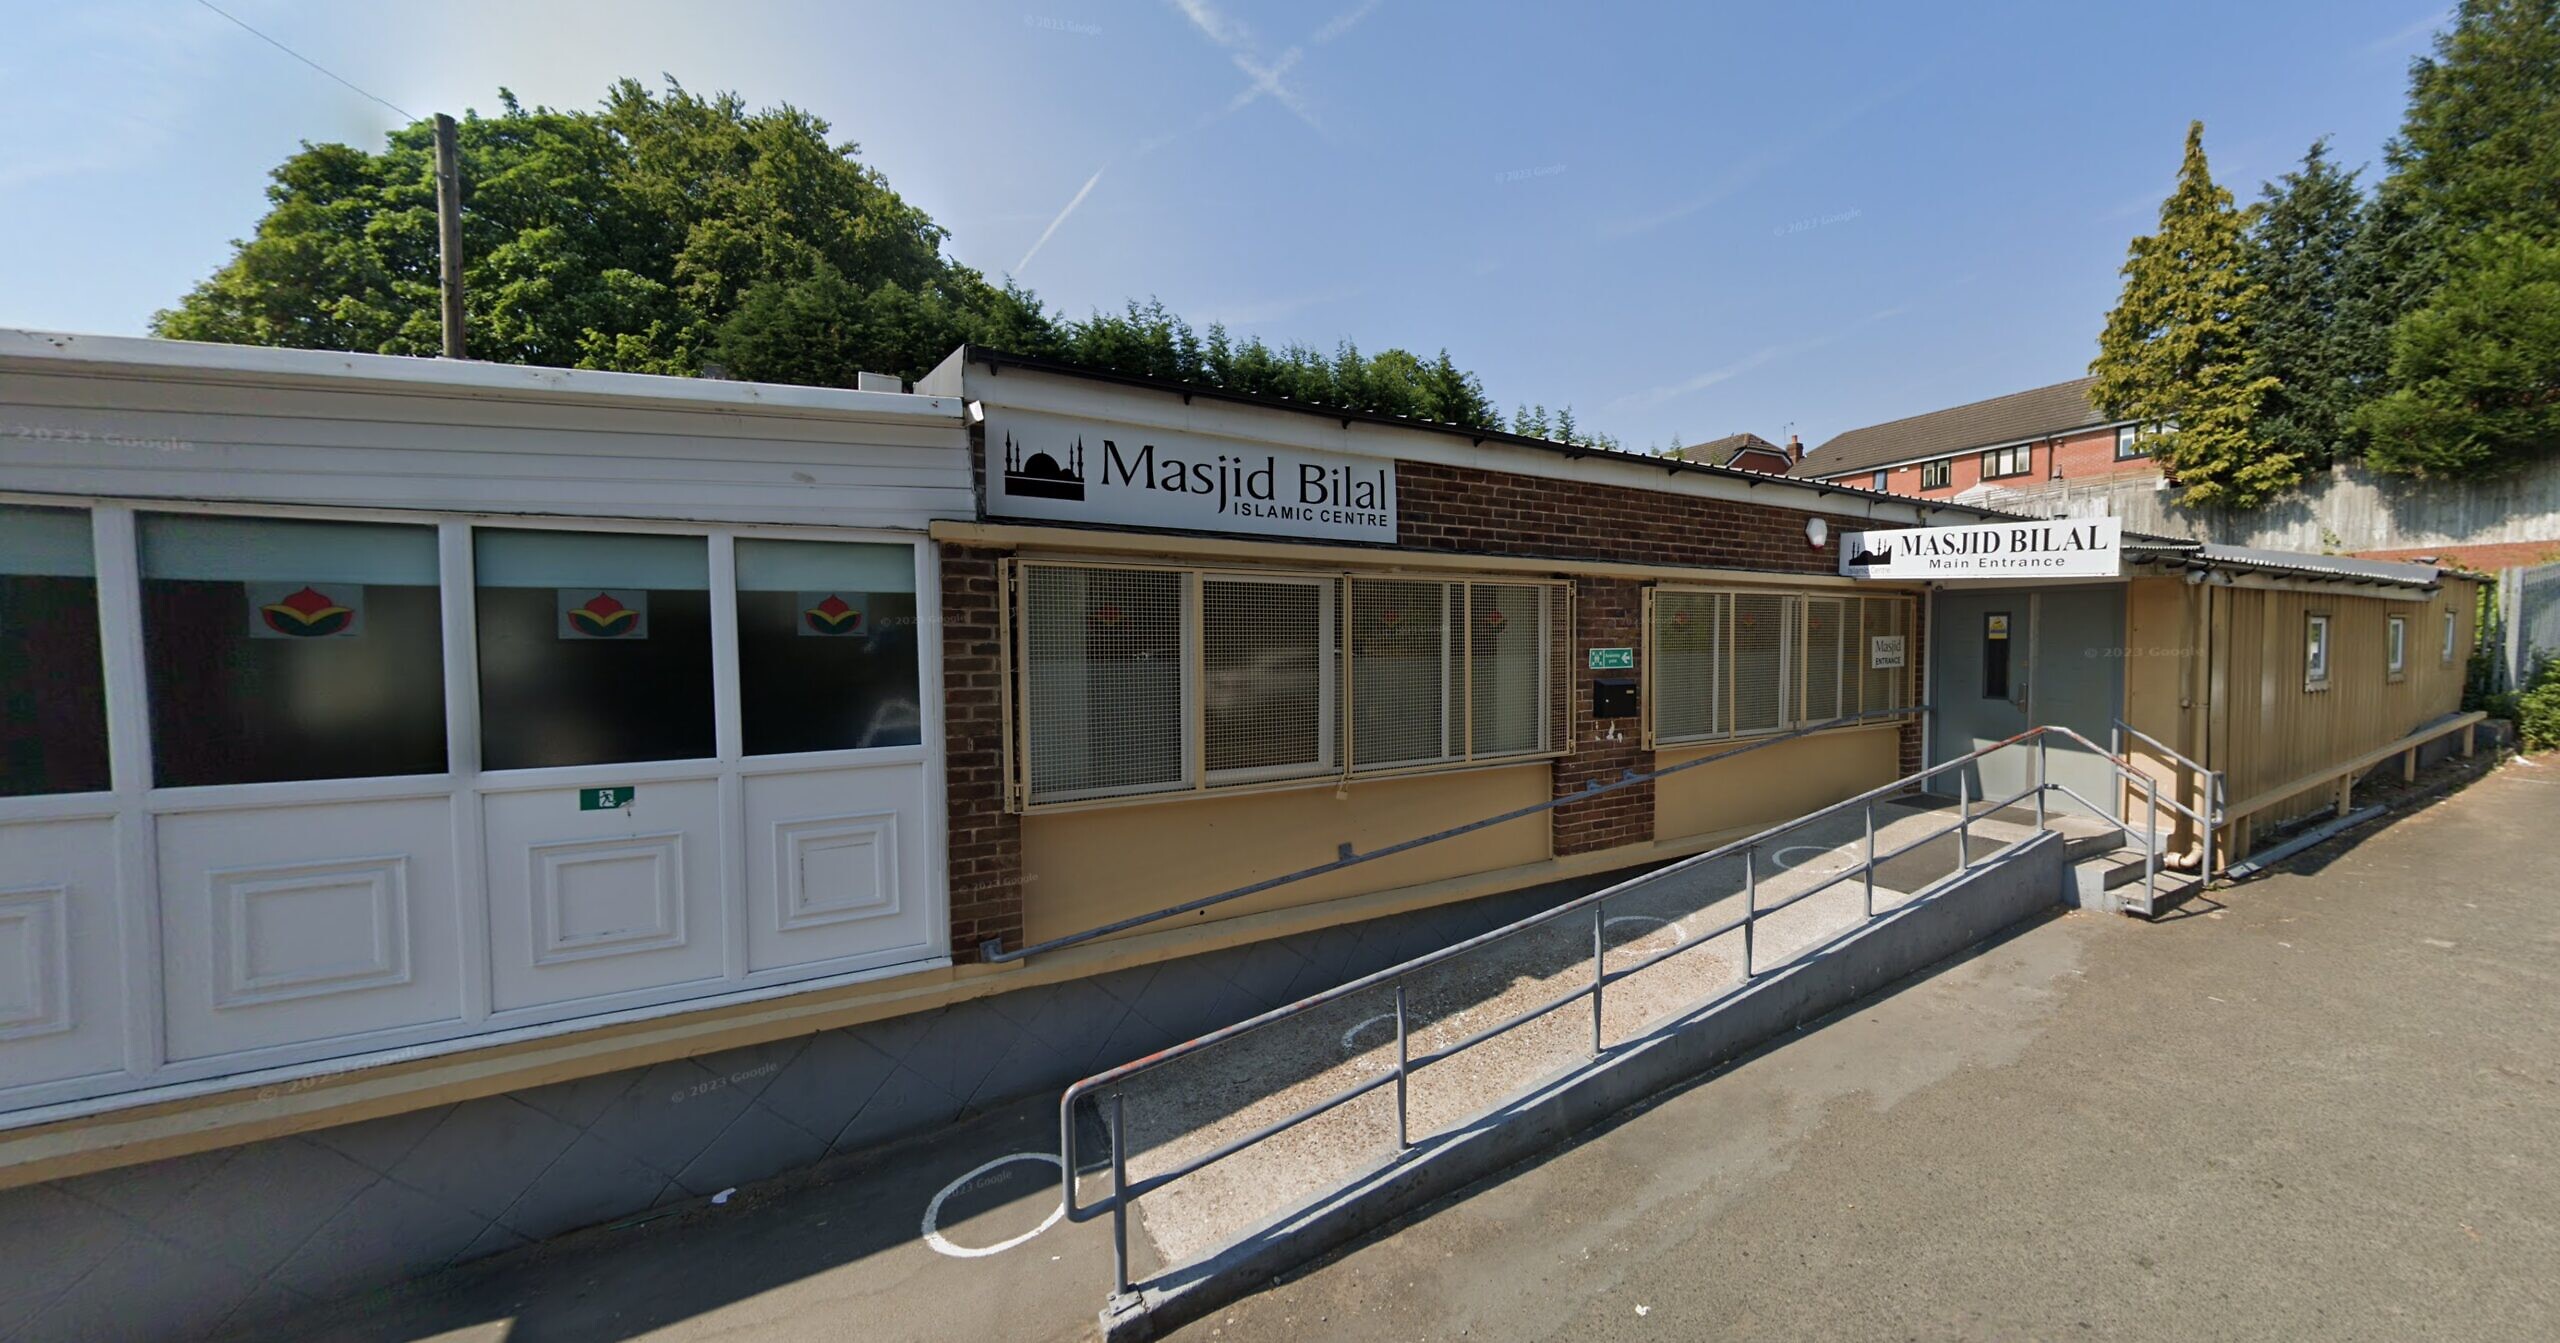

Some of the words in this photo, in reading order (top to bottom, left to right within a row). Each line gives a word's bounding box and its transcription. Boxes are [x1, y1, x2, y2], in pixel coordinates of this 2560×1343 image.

[1100, 439, 1275, 514] Masjid
[1299, 463, 1387, 511] Bilal
[1234, 502, 1314, 522] ISLAMIC
[1320, 509, 1388, 527] CENTRE
[1900, 530, 2001, 557] MASJID
[2010, 525, 2109, 554] BILAL
[1929, 558, 1970, 569] Main
[1978, 557, 2066, 569] Entrance
[1876, 639, 1901, 656] Masjid
[1875, 656, 1901, 666] ENTRANCE
